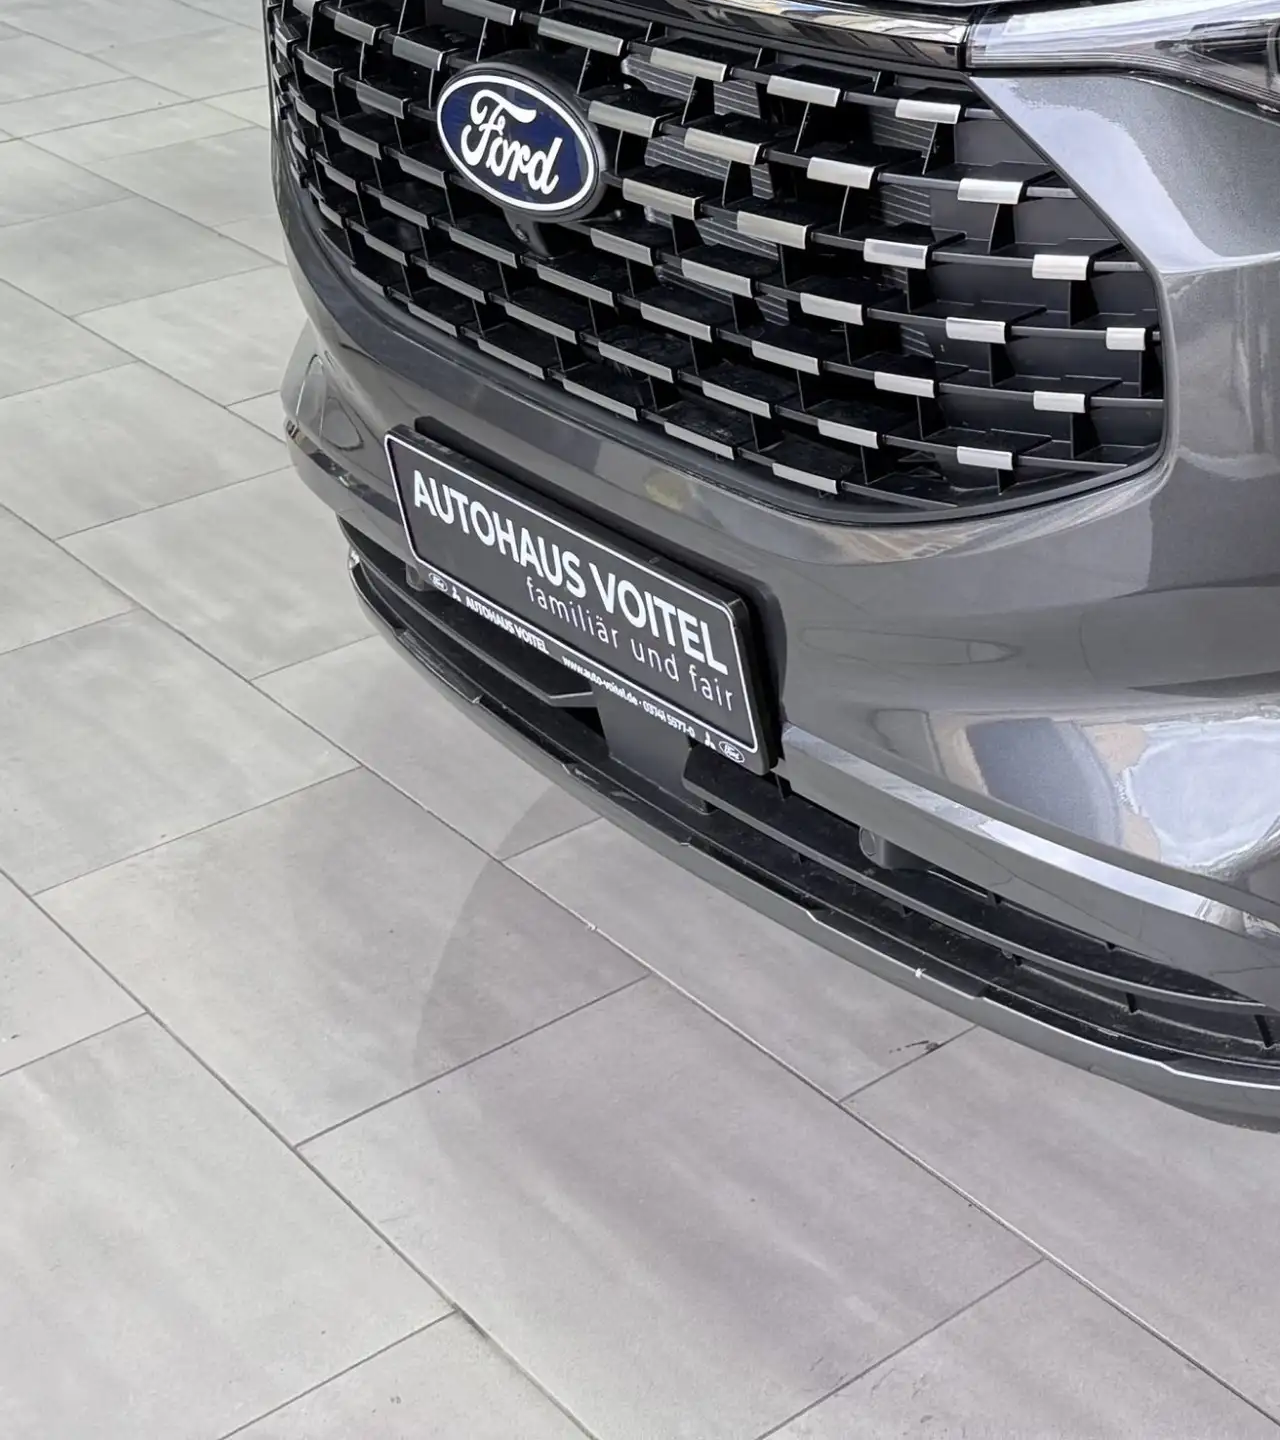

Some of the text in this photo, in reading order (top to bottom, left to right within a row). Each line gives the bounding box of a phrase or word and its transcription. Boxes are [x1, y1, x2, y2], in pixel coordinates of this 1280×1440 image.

[460, 88, 564, 195] Ford
[413, 469, 729, 676] AUTOHAUS VOITEL
[465, 595, 550, 655] AUTOHAUS VOITEL
[526, 575, 734, 712] familiär und fair
